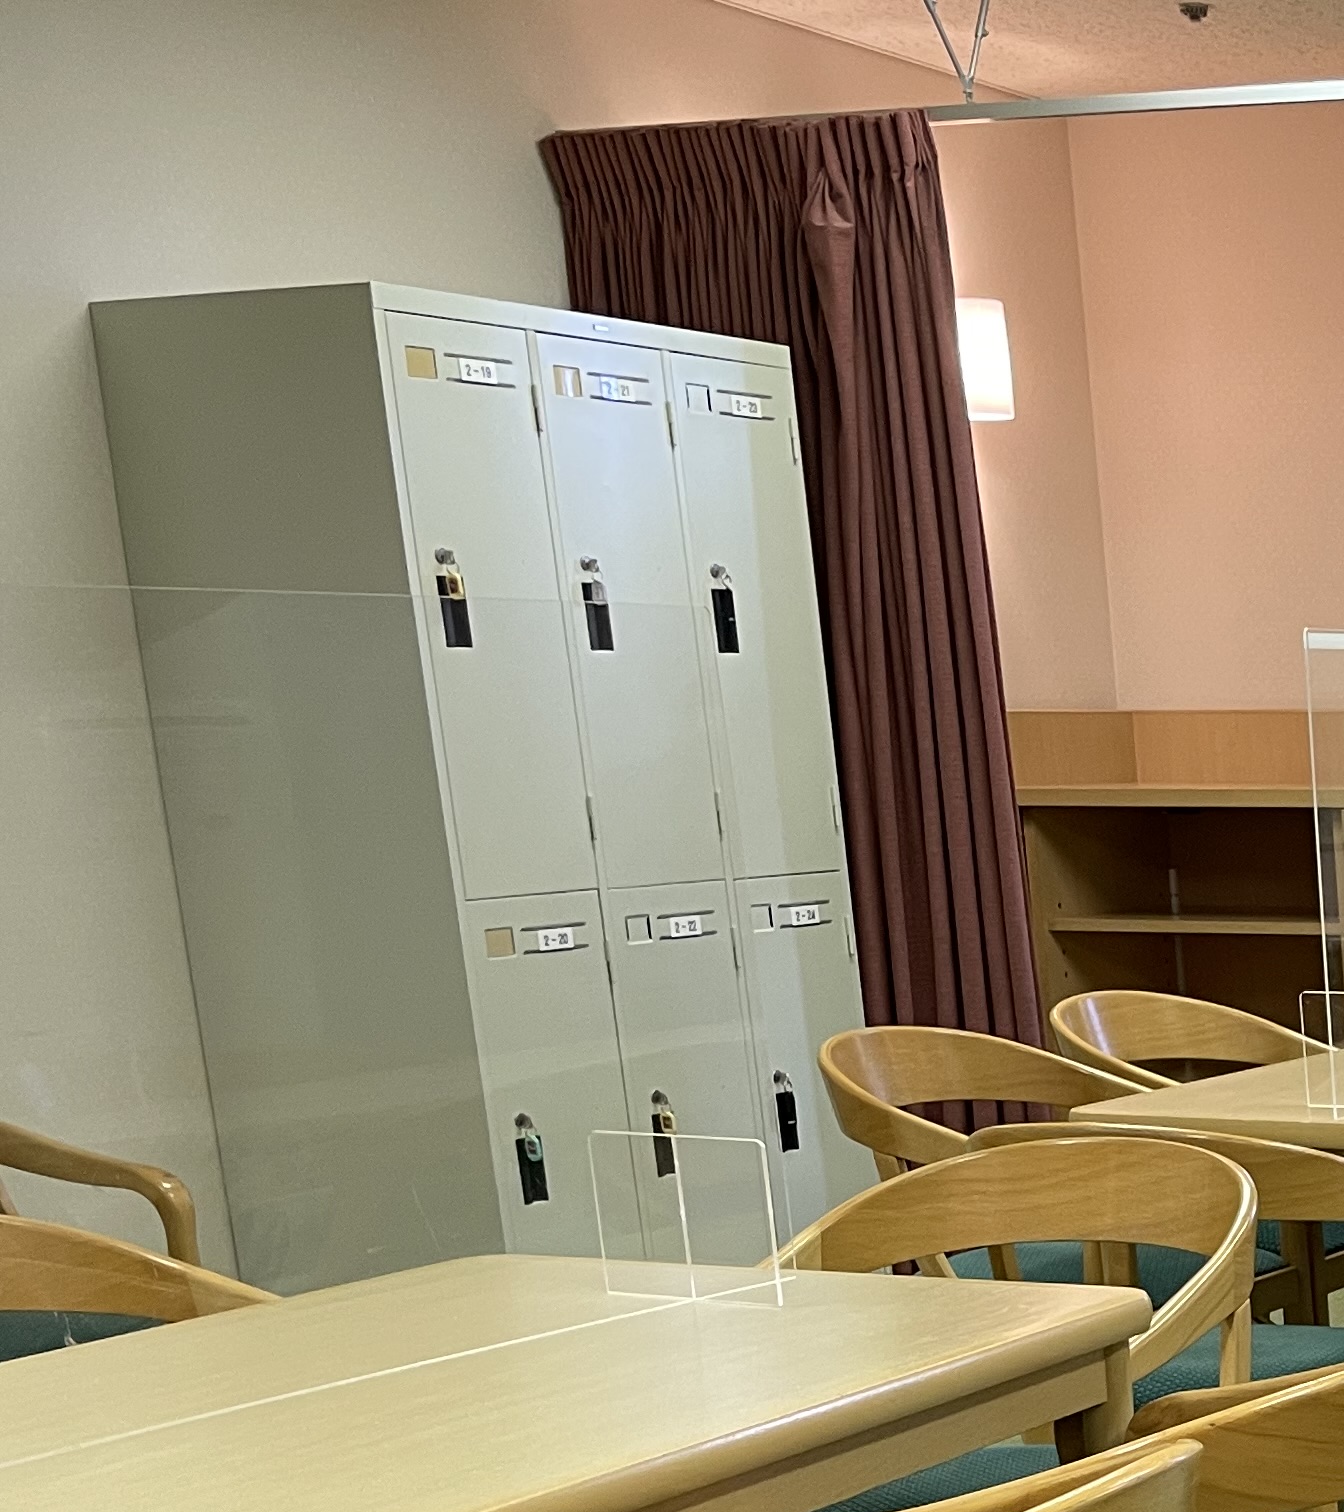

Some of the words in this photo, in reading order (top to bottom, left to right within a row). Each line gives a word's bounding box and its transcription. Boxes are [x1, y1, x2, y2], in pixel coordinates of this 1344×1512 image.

[464, 363, 492, 379] 2-19
[604, 379, 631, 397] 2-21
[735, 399, 758, 414] 2-23
[794, 909, 817, 922] 2-24
[673, 919, 698, 934] 2-22
[542, 932, 569, 947] 2-20
